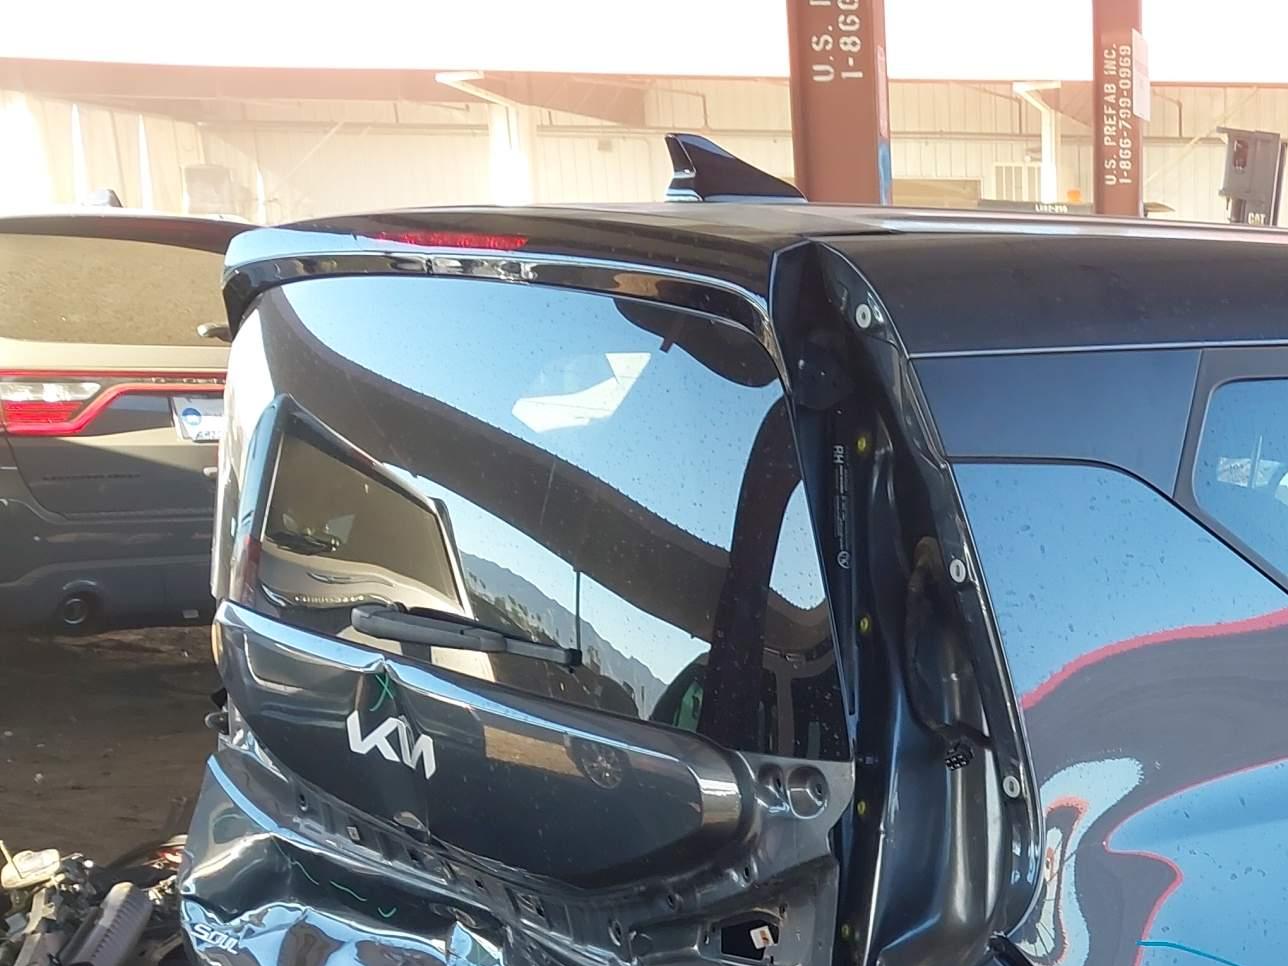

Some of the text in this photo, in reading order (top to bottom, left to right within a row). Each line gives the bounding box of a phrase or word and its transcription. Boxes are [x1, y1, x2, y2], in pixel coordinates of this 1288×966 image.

[811, 25, 835, 82] U.S.
[1103, 83, 1117, 146] PREFAB
[1118, 44, 1132, 184] 1-866-799-0969
[1104, 154, 1117, 185] U.S.
[1248, 212, 1266, 225] CAT
[191, 923, 239, 955] SOUL
